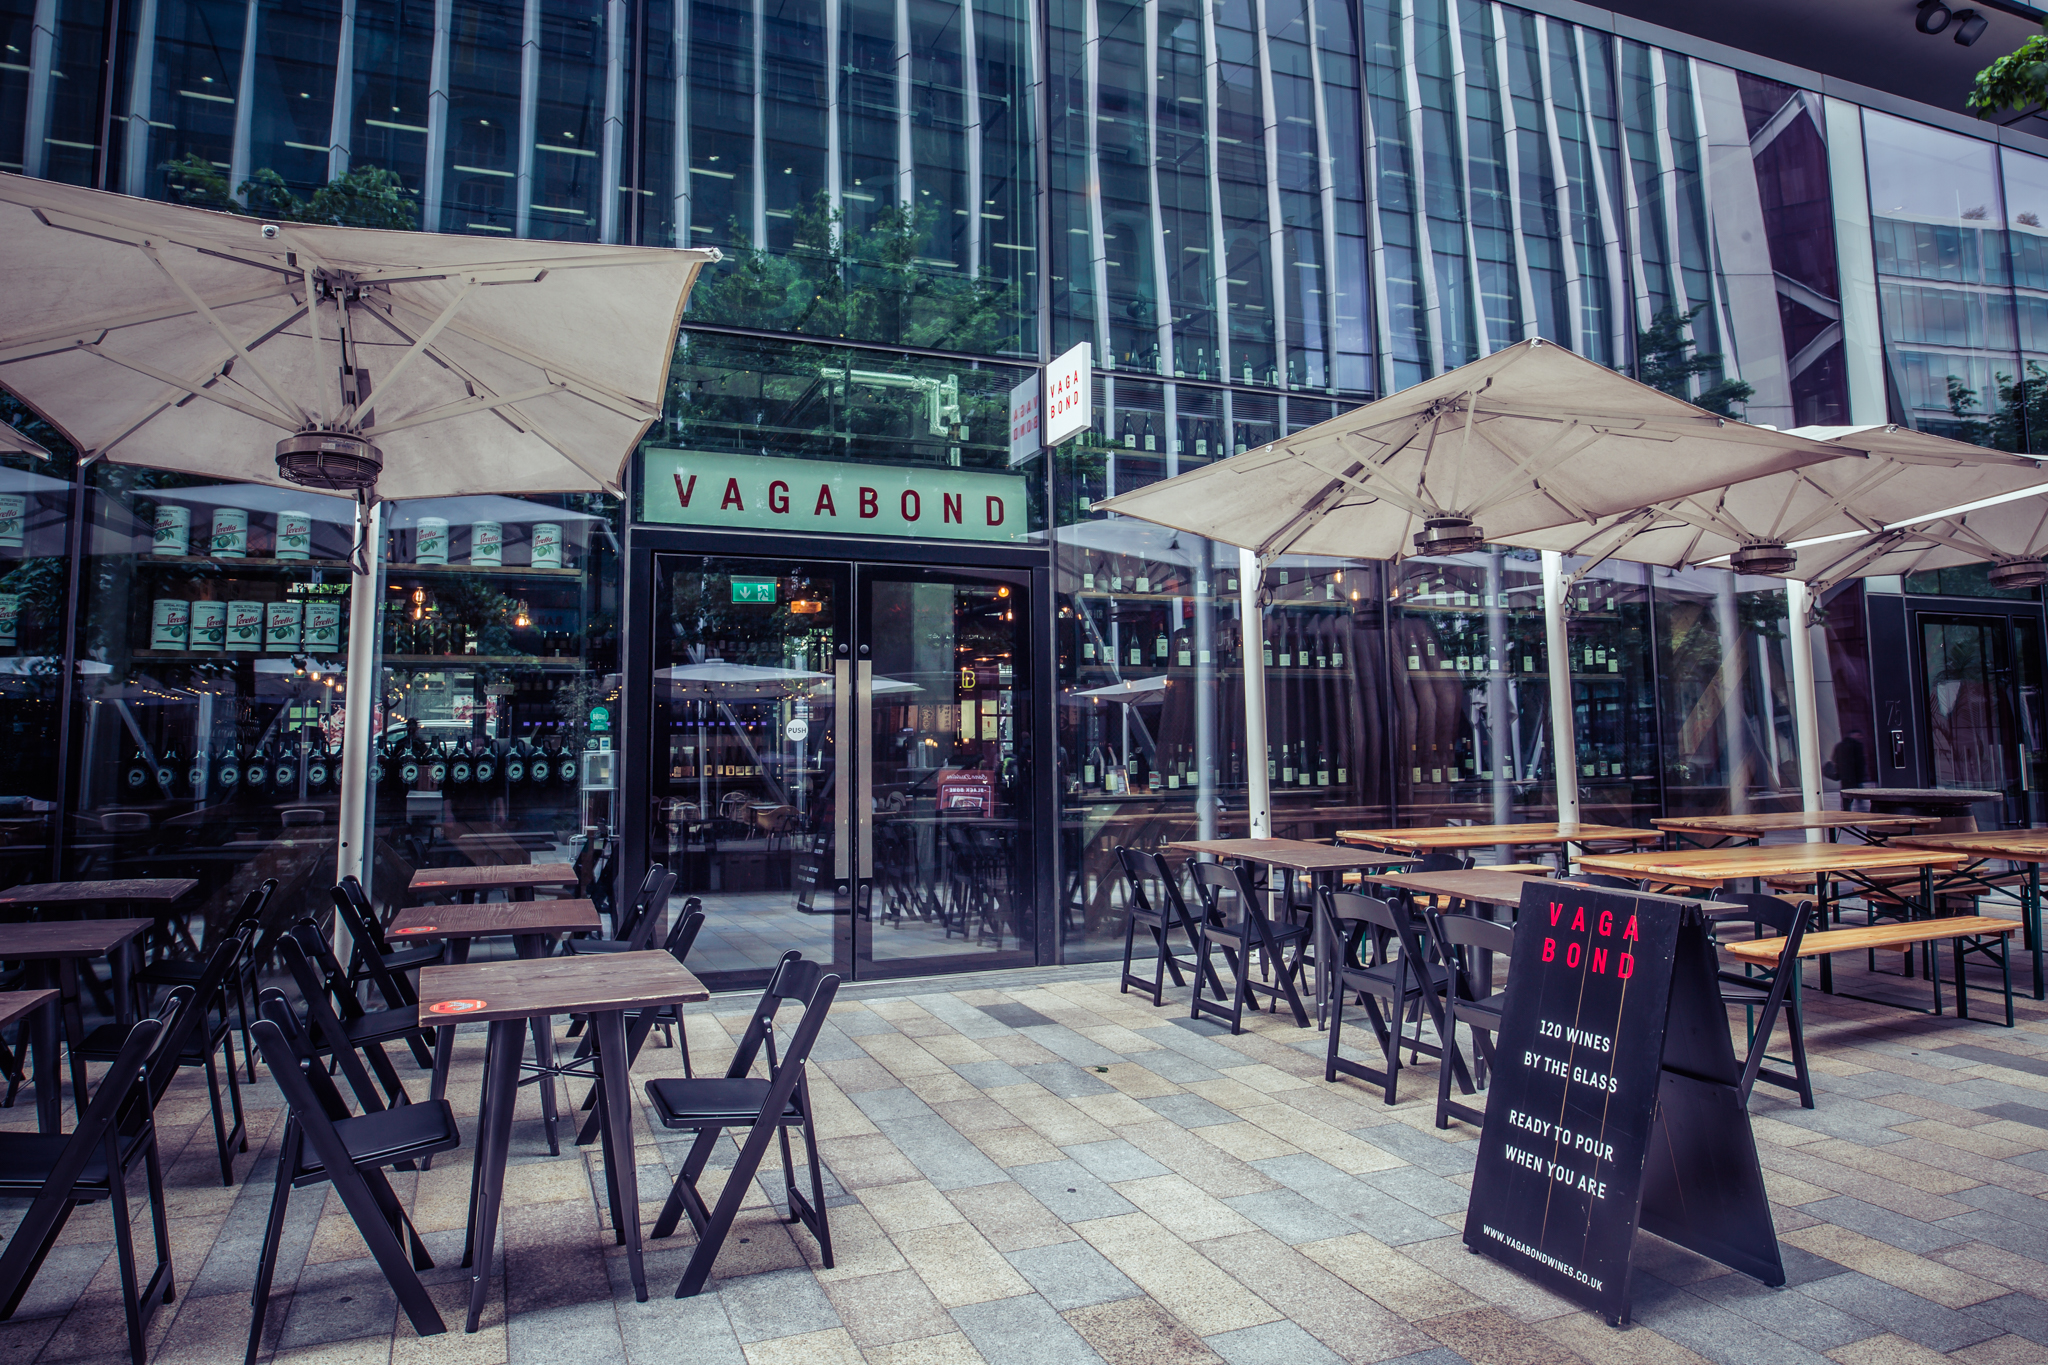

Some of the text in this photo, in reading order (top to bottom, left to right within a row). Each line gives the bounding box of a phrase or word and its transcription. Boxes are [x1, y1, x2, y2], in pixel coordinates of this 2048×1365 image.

[1050, 370, 1079, 398] VAGA
[1050, 391, 1079, 419] BOND
[673, 473, 1005, 527] VAGABOND
[1885, 699, 1902, 726] 75
[1550, 901, 1639, 942] VAGA
[1541, 937, 1635, 979] BOND
[1539, 1019, 1611, 1053] 120 WINES
[1523, 1050, 1618, 1093] BY THE GLASS
[1509, 1109, 1614, 1162] READY TO POUR
[1505, 1143, 1607, 1199] WHEN YOU ARE
[1483, 1224, 1603, 1292] WWW.VAGABONDWINES.CO.UK
